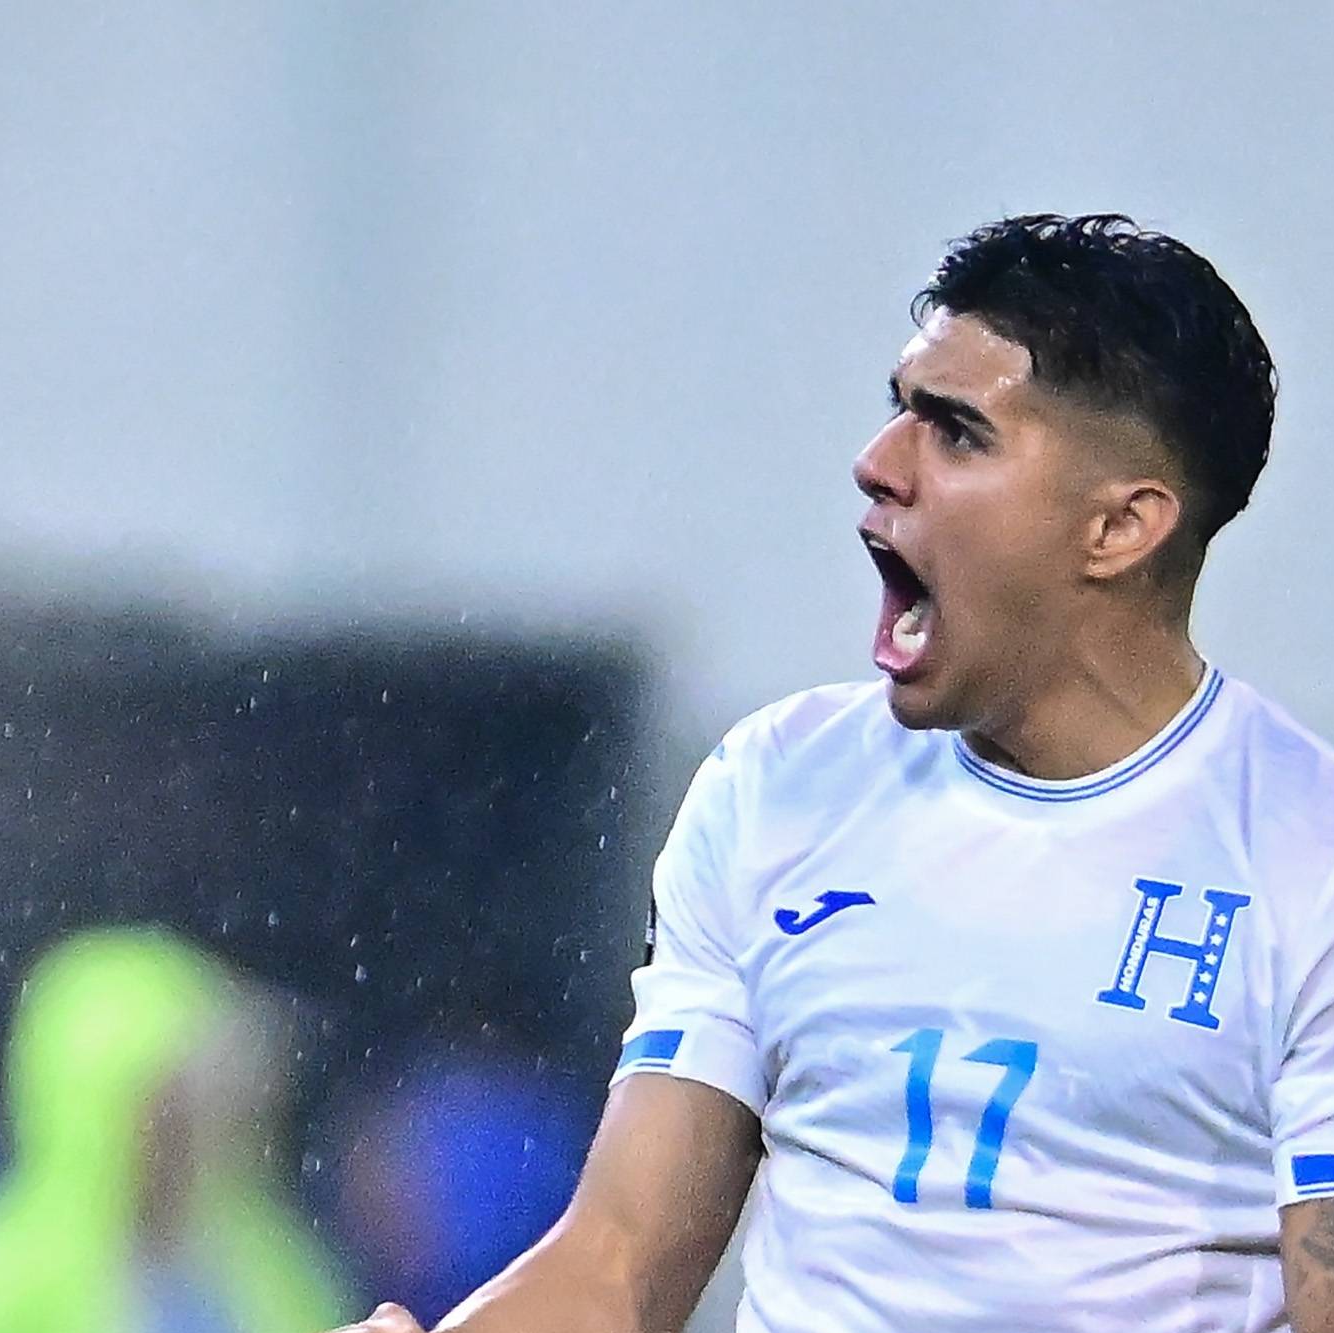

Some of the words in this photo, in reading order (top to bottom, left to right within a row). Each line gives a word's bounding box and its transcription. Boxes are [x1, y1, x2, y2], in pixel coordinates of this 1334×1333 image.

[1095, 876, 1252, 1031] H
[1118, 896, 1159, 993] HONDURAS
[889, 1027, 1039, 1210] 17
